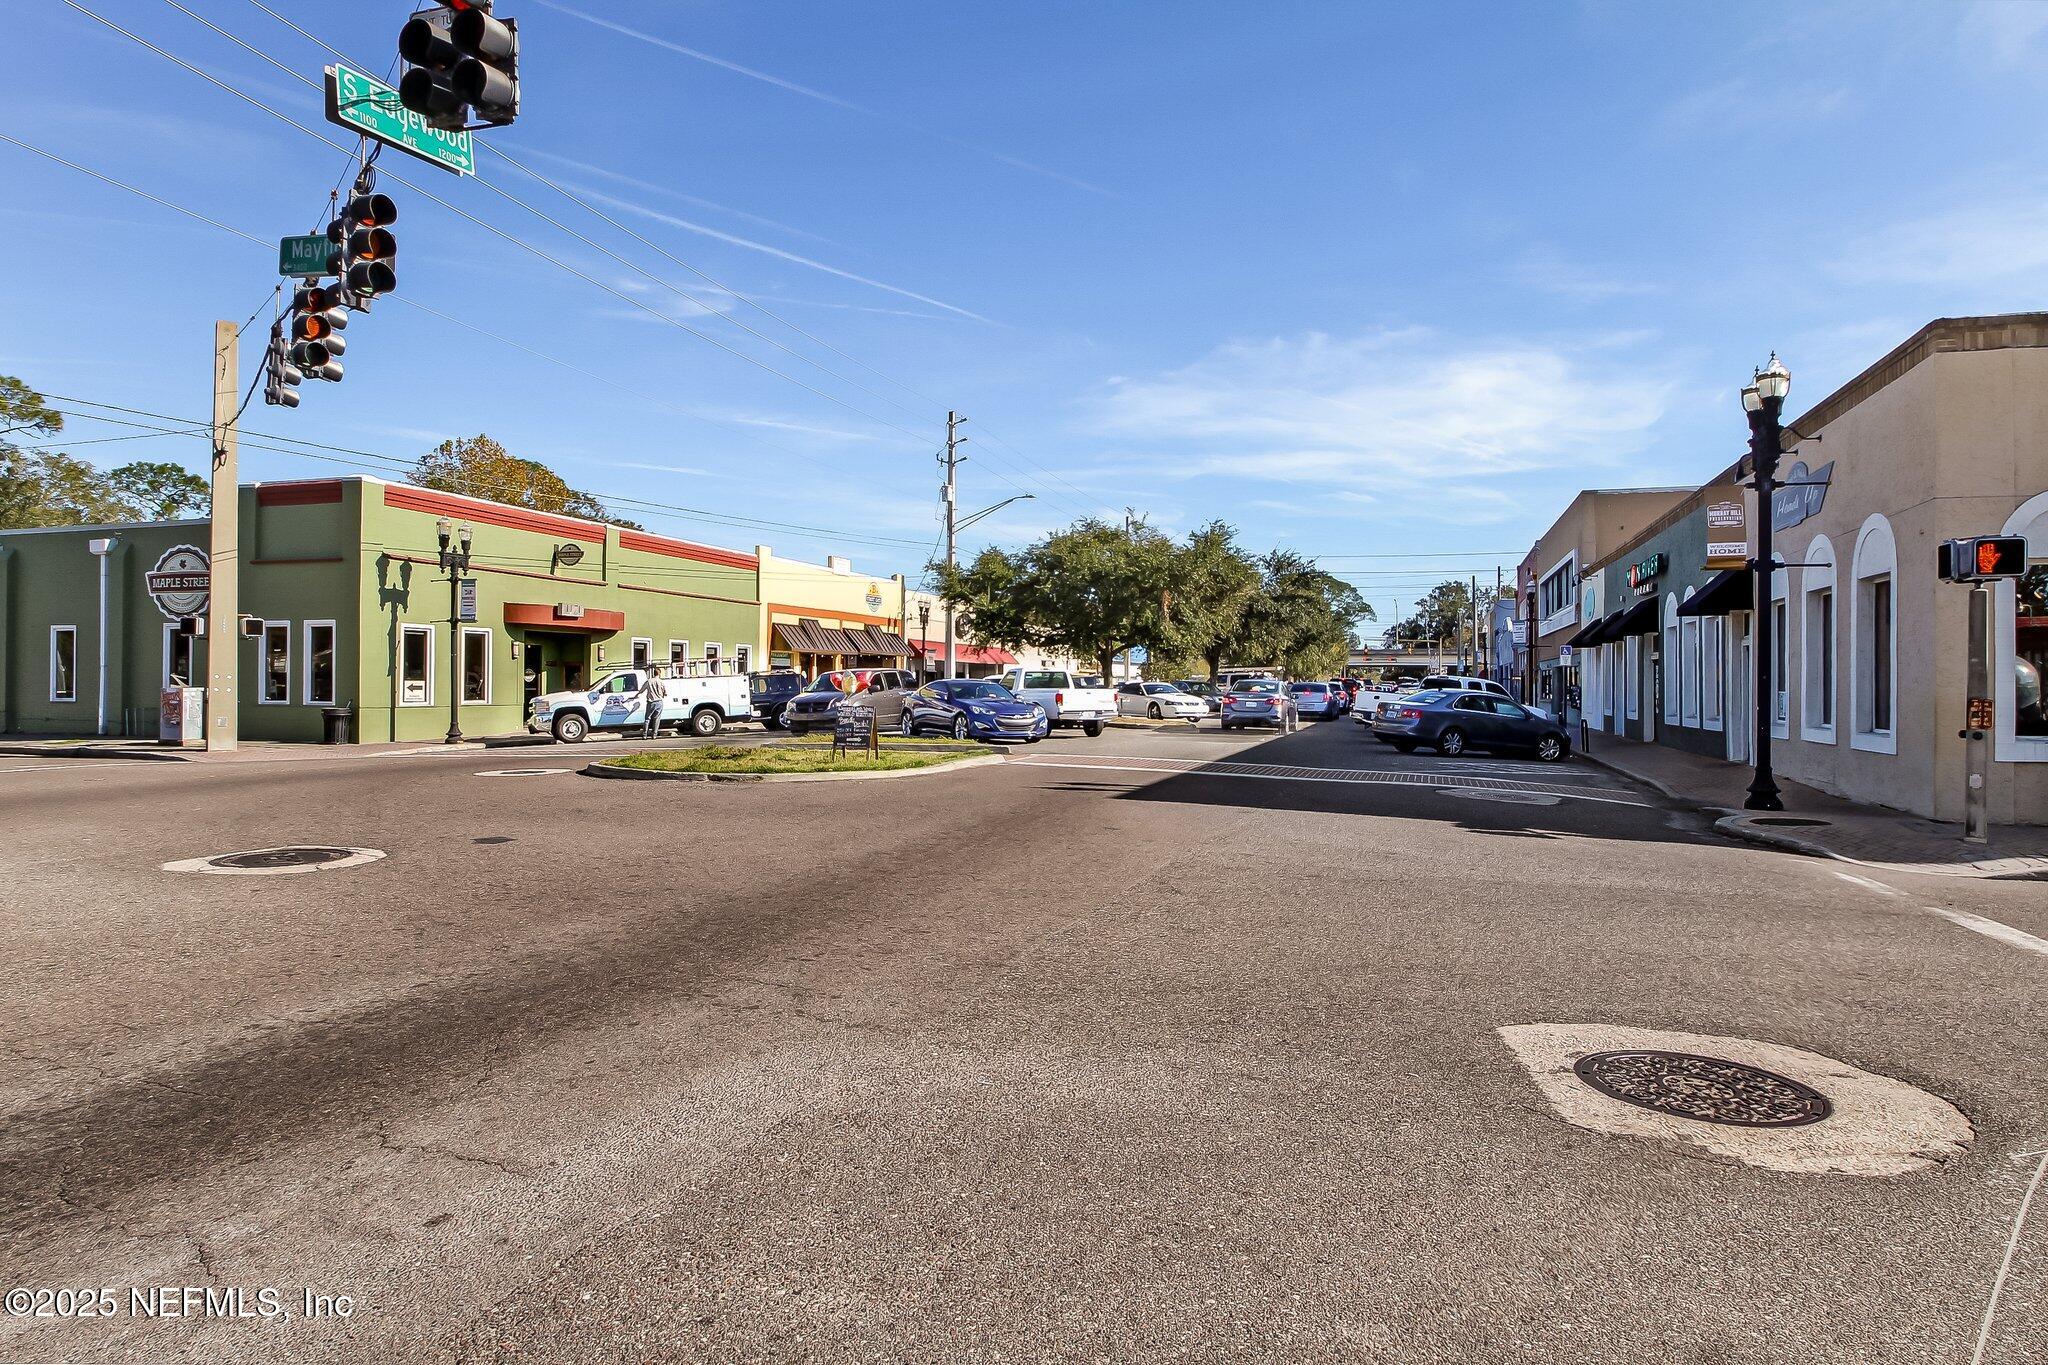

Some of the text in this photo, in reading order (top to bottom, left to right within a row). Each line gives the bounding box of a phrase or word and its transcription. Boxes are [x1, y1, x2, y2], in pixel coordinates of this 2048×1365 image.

[343, 73, 357, 101] S
[359, 111, 378, 128] 1100
[402, 133, 418, 149] AVE
[438, 147, 457, 163] 1200
[152, 576, 210, 588] MAPLE STREE
